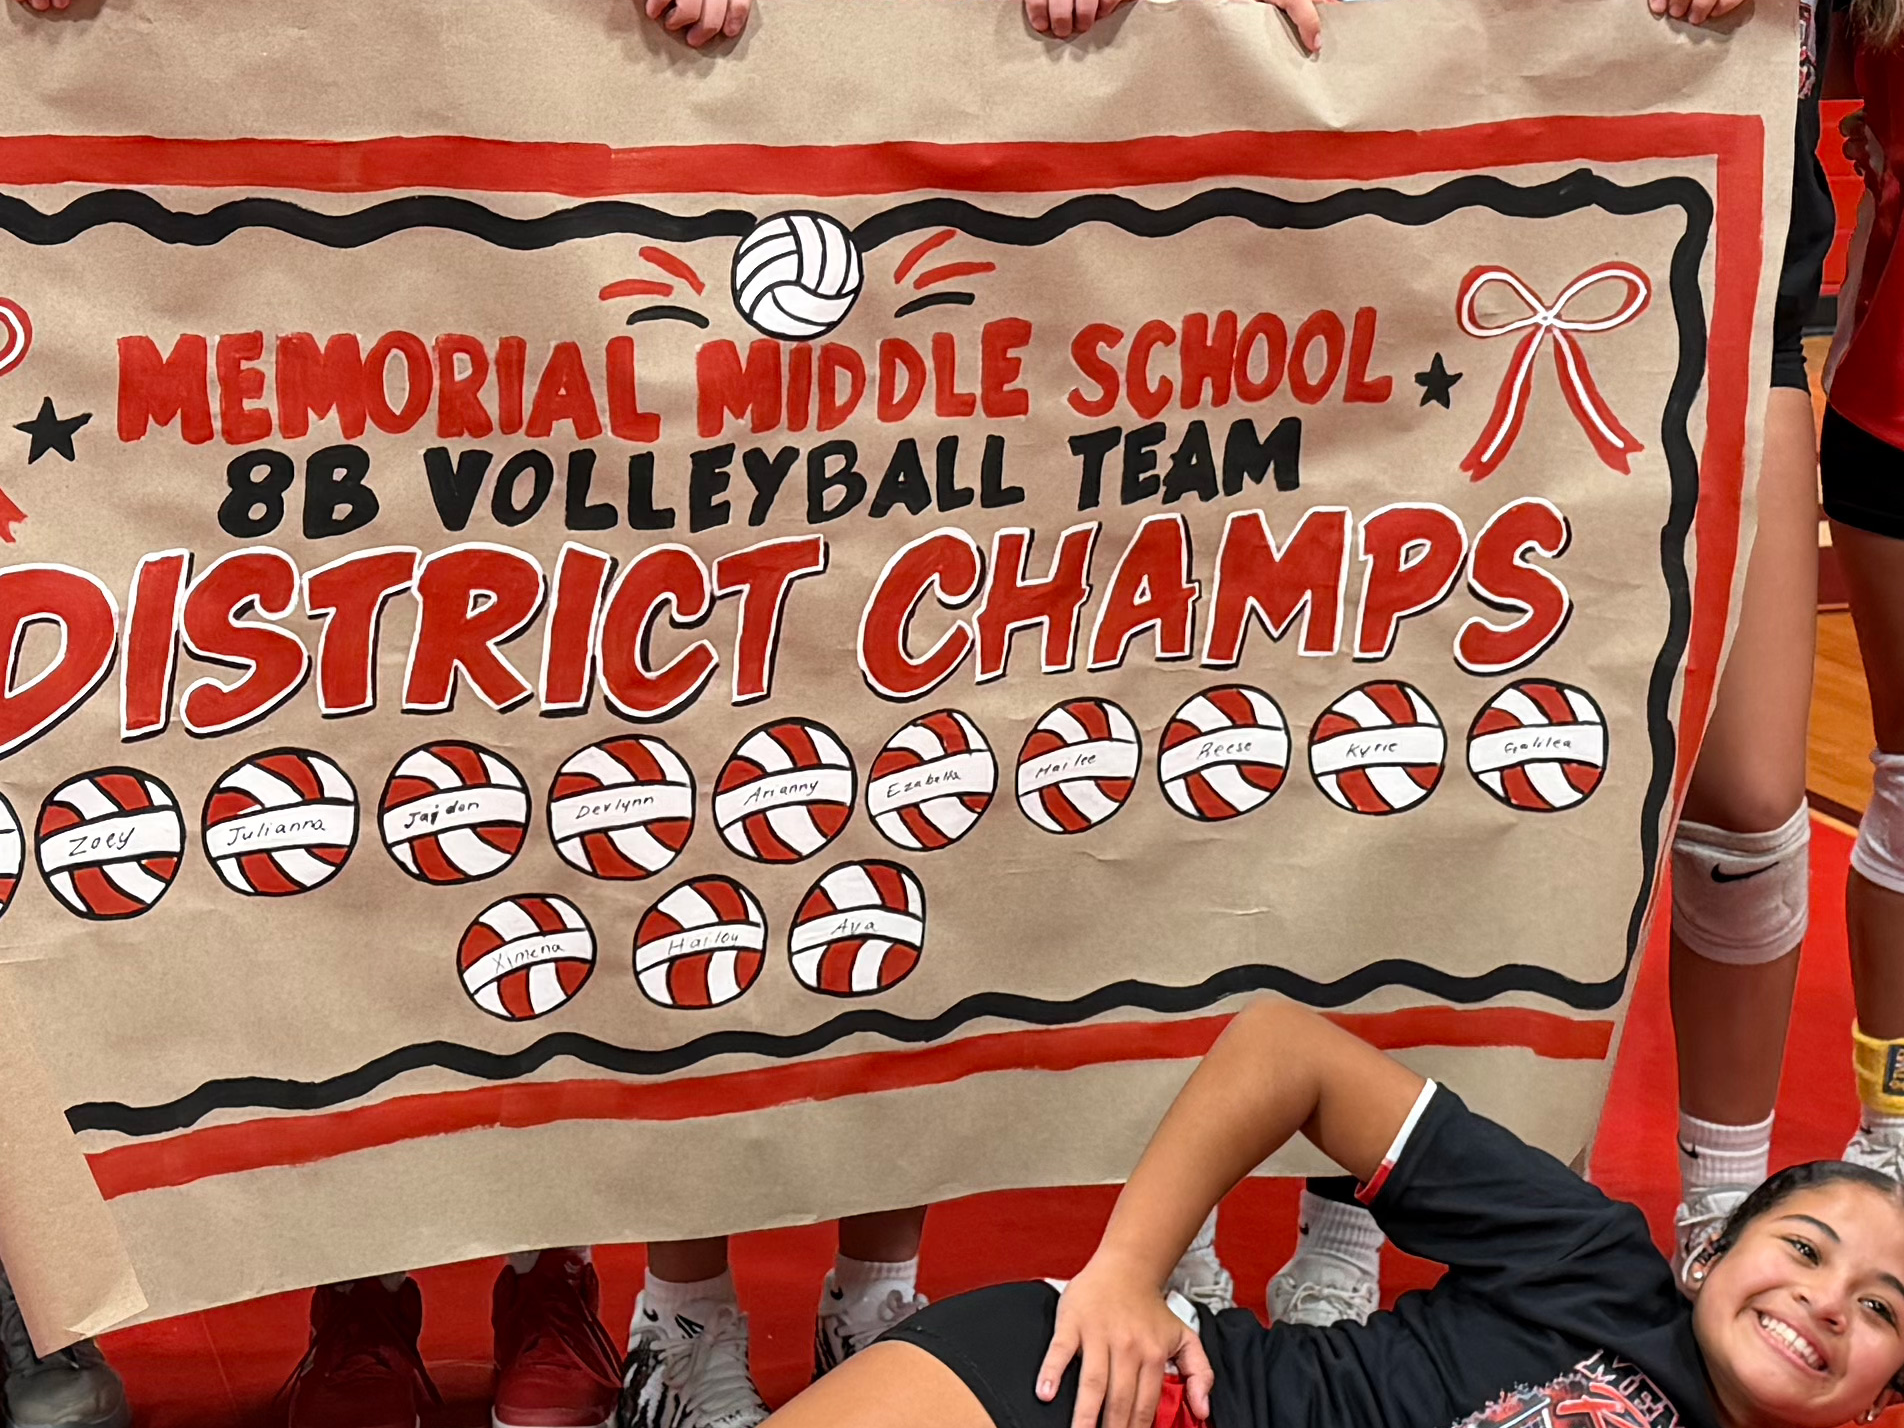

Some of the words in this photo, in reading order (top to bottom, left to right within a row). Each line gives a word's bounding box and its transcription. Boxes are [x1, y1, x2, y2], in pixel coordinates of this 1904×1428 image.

[114, 329, 662, 445] MEMORIAL
[695, 317, 1033, 440] MIDDLE
[1066, 305, 1394, 421] SCHOOL
[216, 444, 380, 541] 8B
[423, 434, 1026, 533] VOLLEYBALL
[1068, 415, 1303, 512] TEAM
[856, 495, 1574, 705] CHAMPS
[1196, 740, 1253, 760] Reese
[1345, 740, 1398, 759] Kyrie
[69, 827, 136, 857] Zoey
